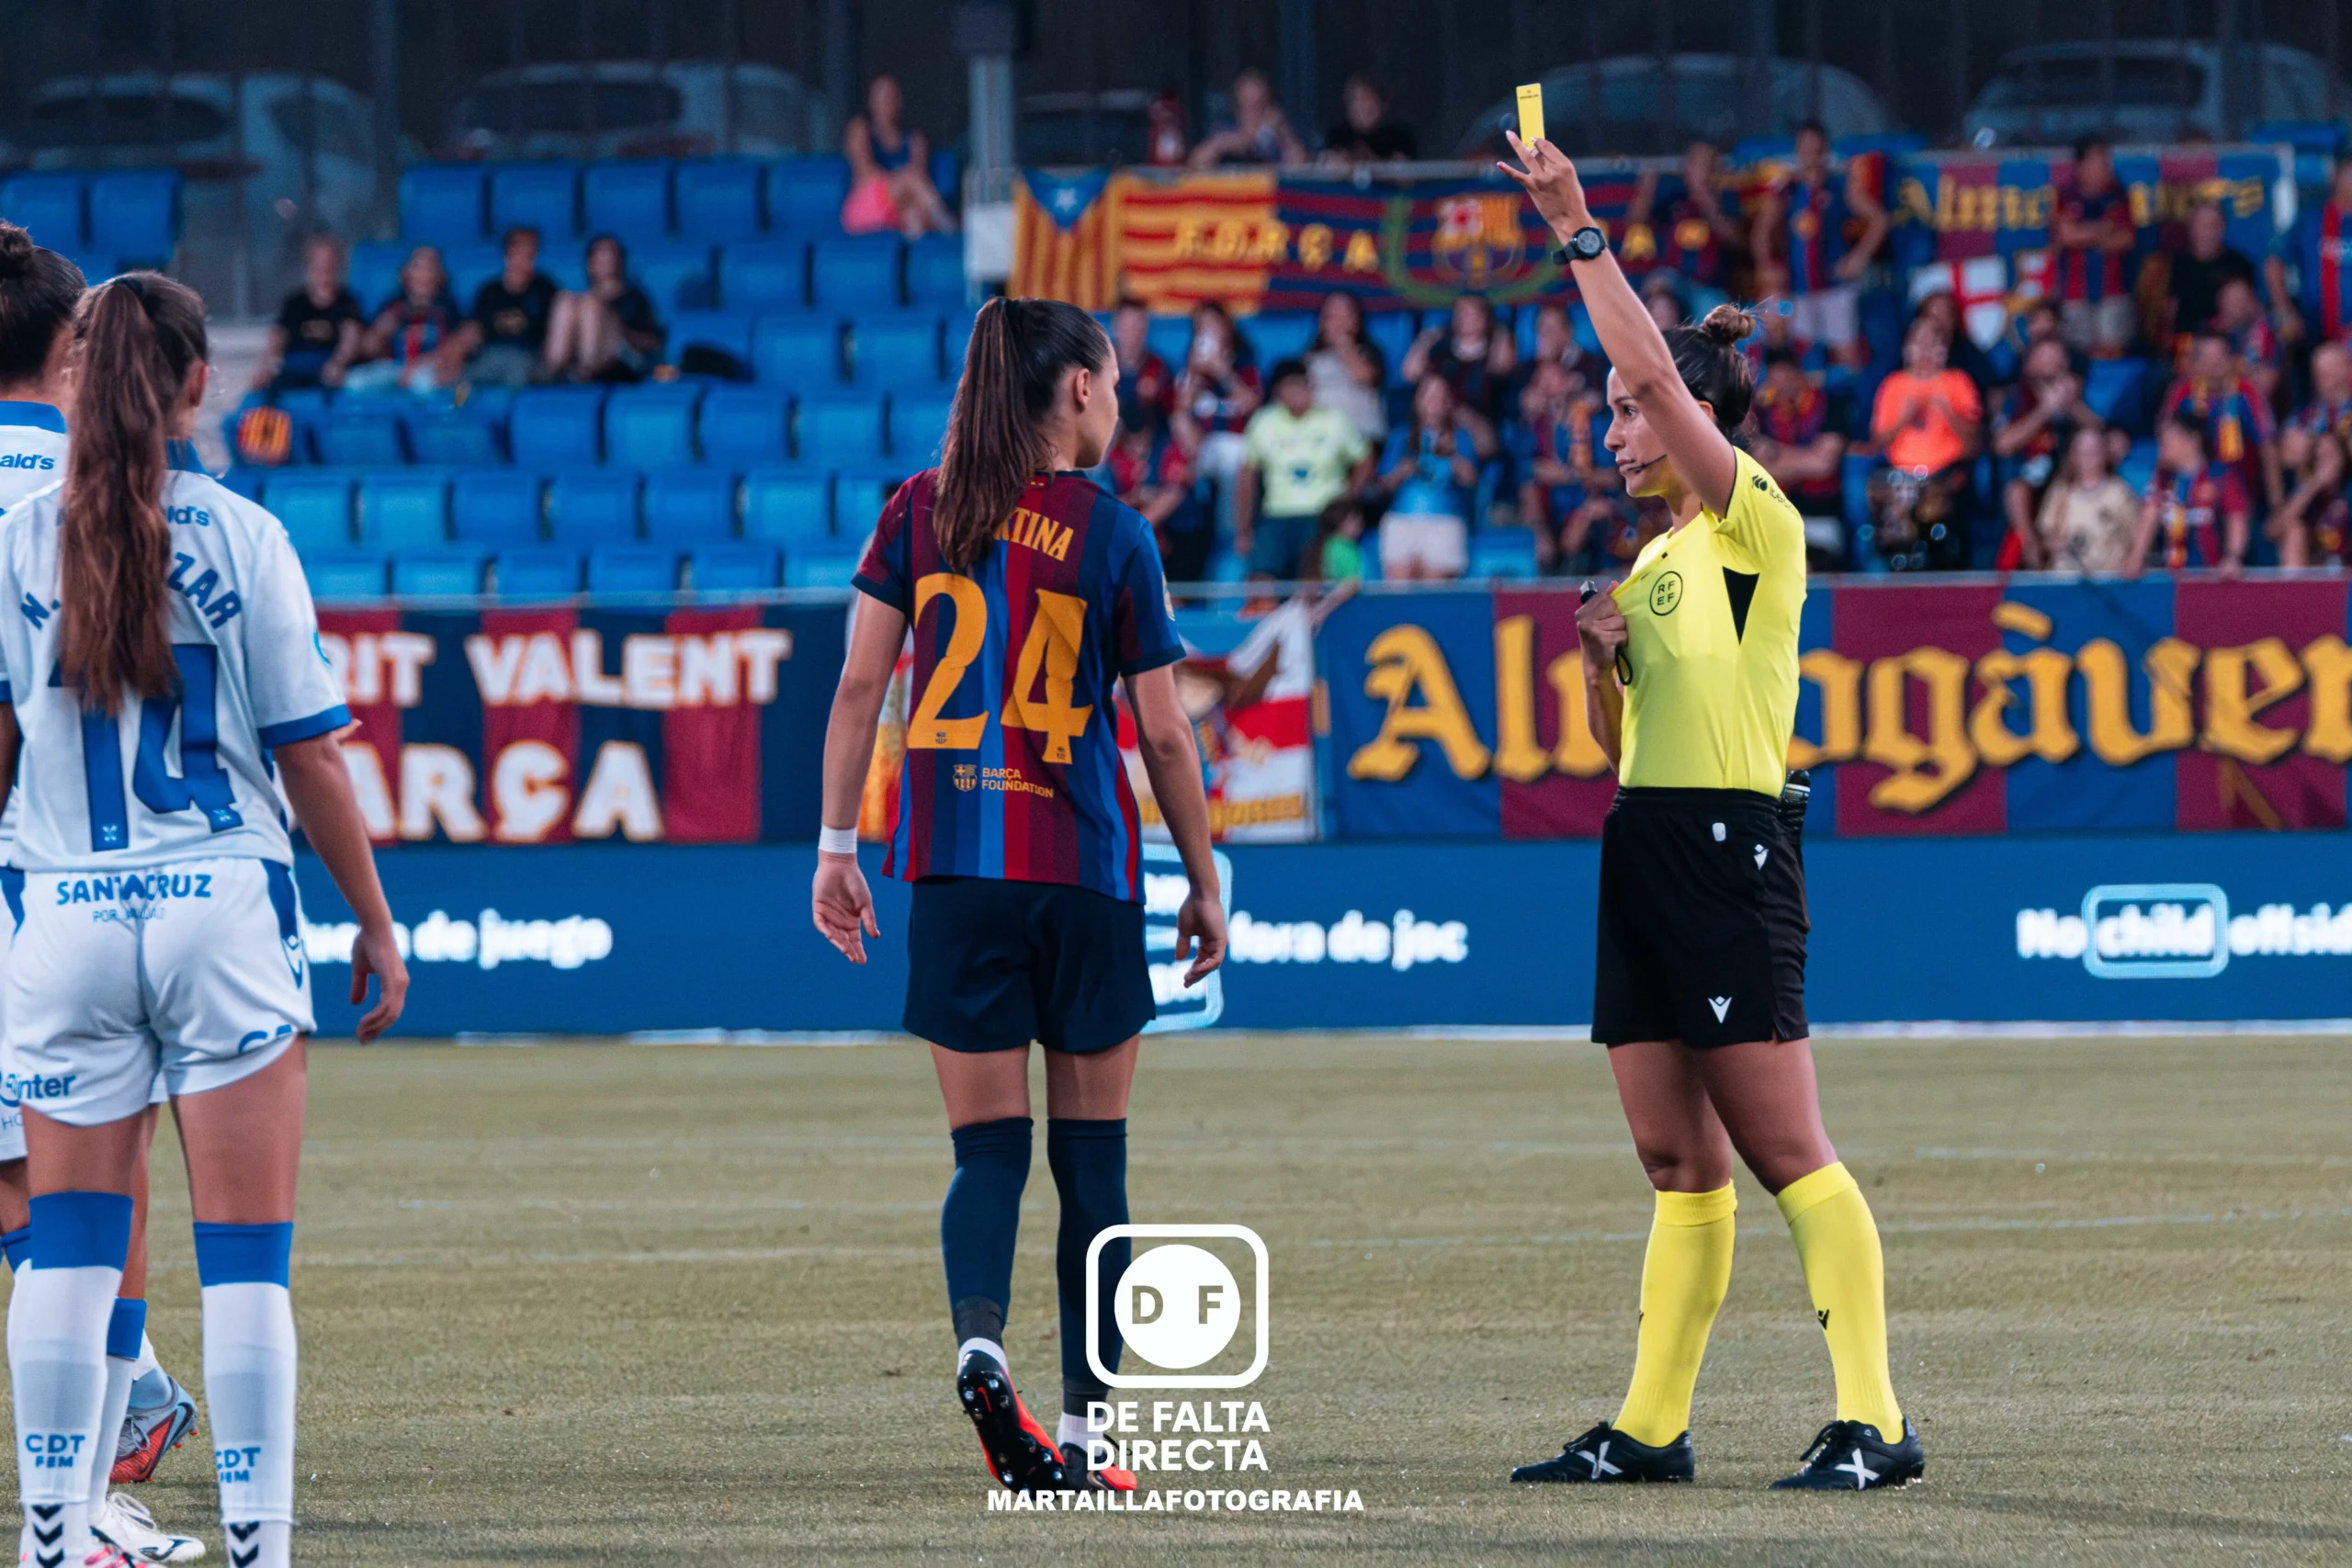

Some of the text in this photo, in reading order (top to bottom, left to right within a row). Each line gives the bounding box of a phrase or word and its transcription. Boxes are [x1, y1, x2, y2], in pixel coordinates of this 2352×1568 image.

[993, 506, 1074, 562] TINA
[465, 628, 794, 709] VALENT
[907, 572, 1094, 765] 24
[981, 779, 1054, 798] FOUNDATION
[982, 767, 1022, 780] BARÇA
[56, 874, 145, 906] SANA
[25, 1434, 85, 1454] CDT
